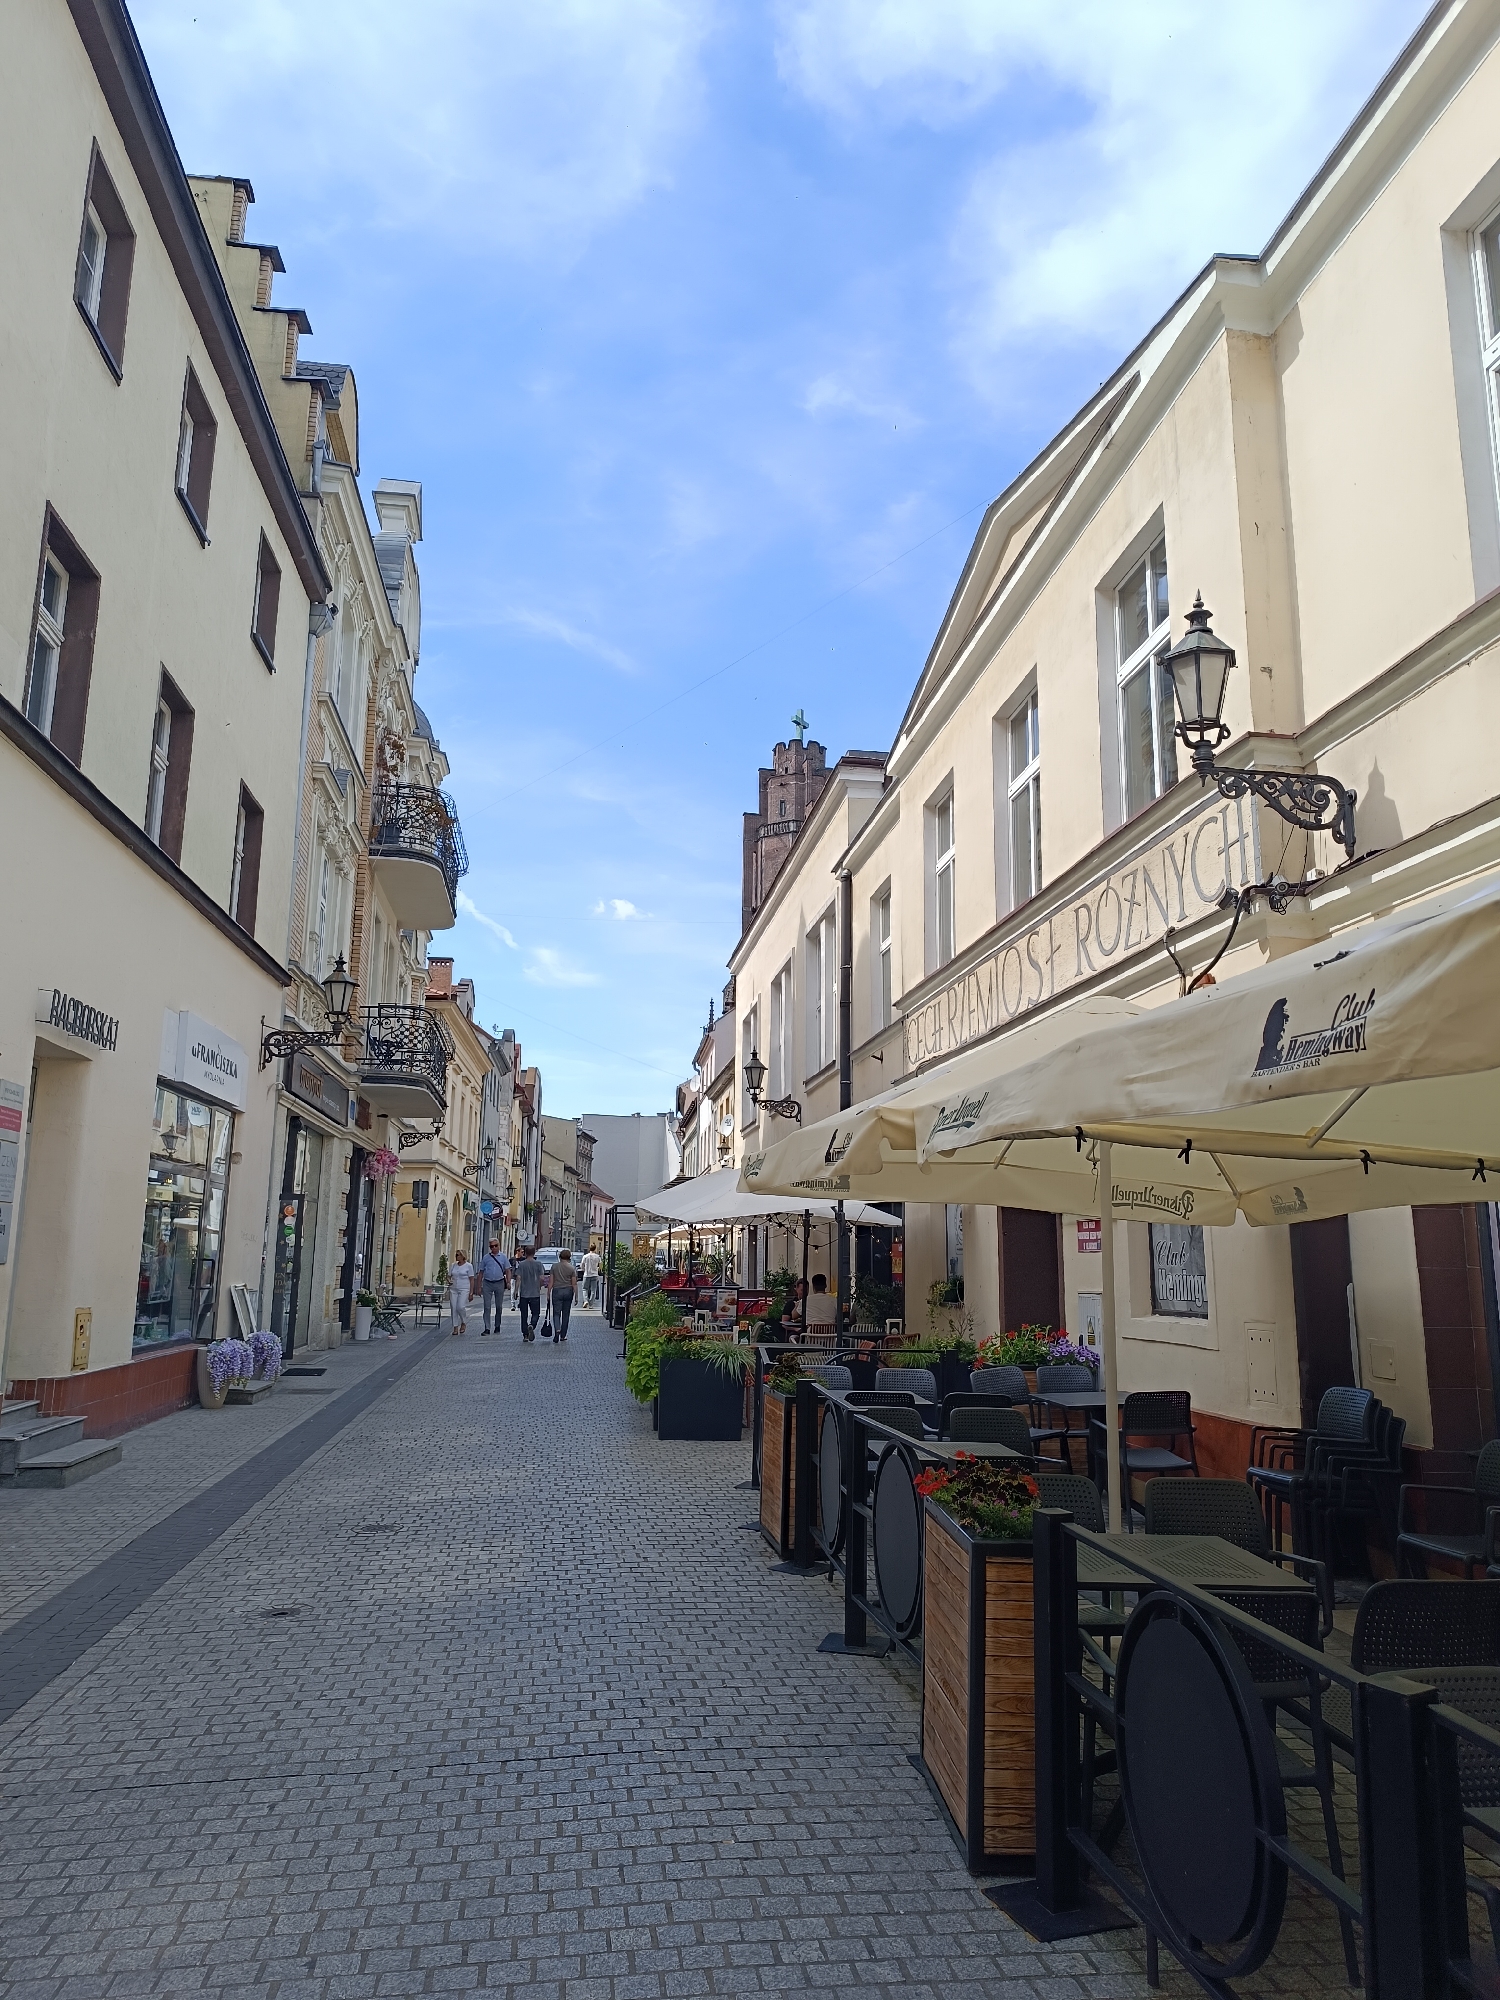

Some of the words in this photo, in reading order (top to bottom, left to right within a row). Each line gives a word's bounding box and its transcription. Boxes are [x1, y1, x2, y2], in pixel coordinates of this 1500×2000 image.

[906, 1001, 944, 1066] CECH
[947, 919, 1061, 1049] RZEMIOSŁ
[1330, 987, 1376, 1031] Club
[1282, 1022, 1364, 1063] Hemingway
[1302, 1057, 1321, 1069] BAR
[1155, 1240, 1189, 1267] Club
